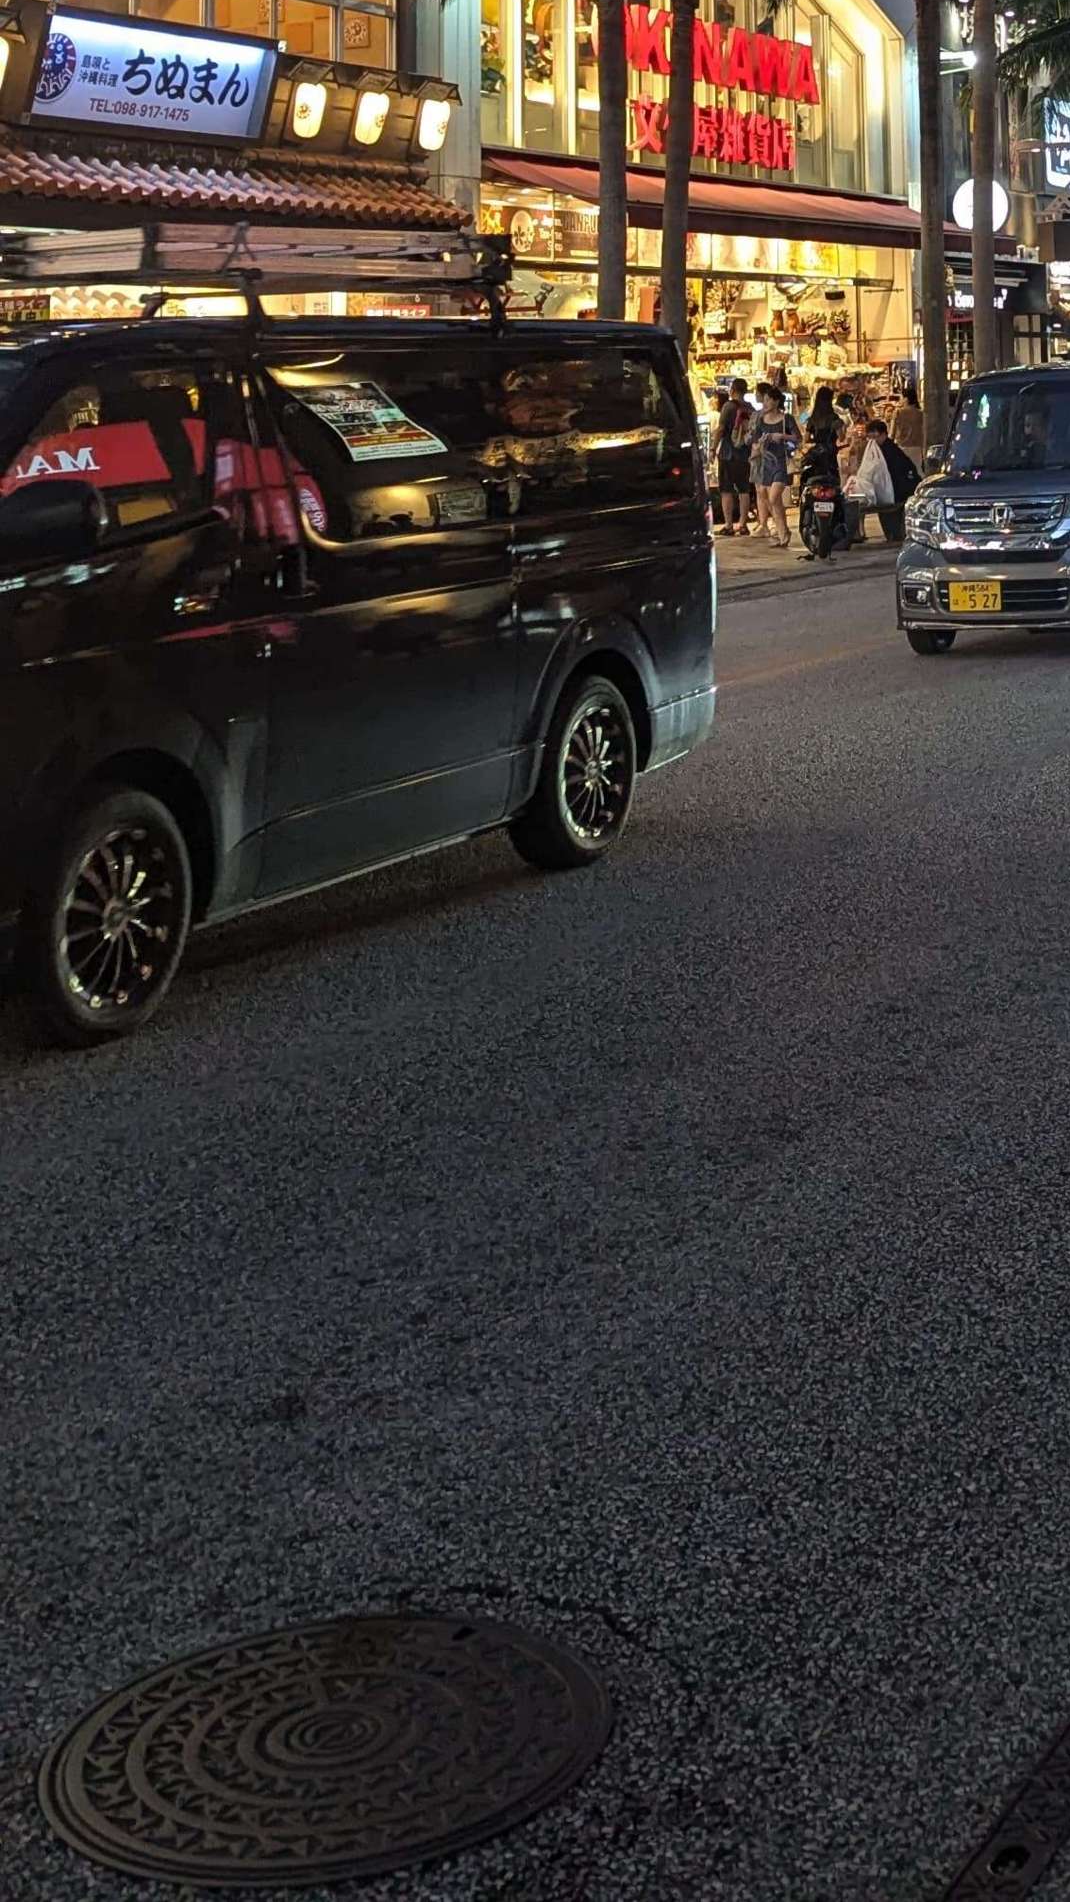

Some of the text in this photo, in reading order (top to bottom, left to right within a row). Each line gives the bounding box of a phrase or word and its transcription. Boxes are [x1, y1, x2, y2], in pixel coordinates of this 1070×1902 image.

[77, 68, 119, 88] 沖縄料理
[122, 49, 249, 108] ちぬまん
[592, 2, 820, 105] KNAWA
[627, 94, 795, 171] 文屋雑貨店
